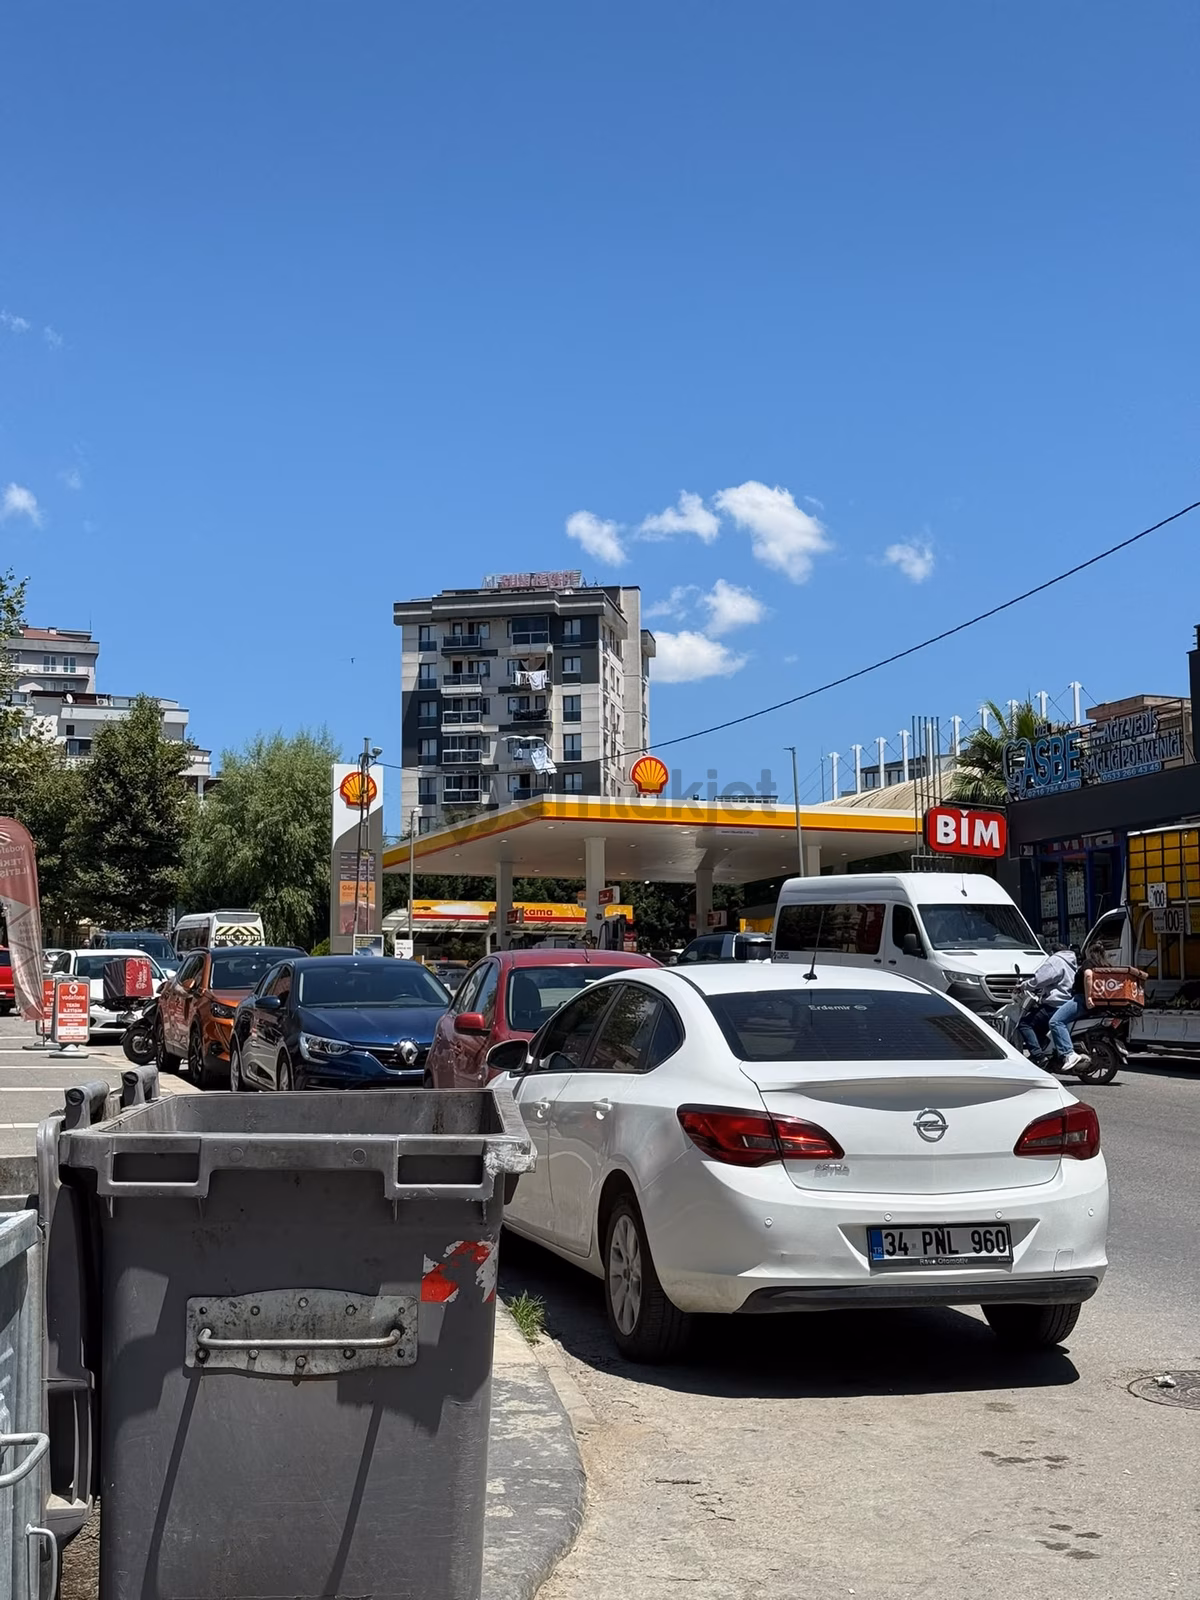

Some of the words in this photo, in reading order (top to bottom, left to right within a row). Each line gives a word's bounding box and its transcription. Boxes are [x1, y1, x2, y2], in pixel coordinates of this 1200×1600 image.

[936, 809, 1000, 849] BİM
[1163, 910, 1180, 932] 100
[873, 1246, 883, 1254] TR
[883, 1231, 909, 1257] 34
[921, 1230, 960, 1255] PNL
[970, 1229, 1007, 1254] 960
